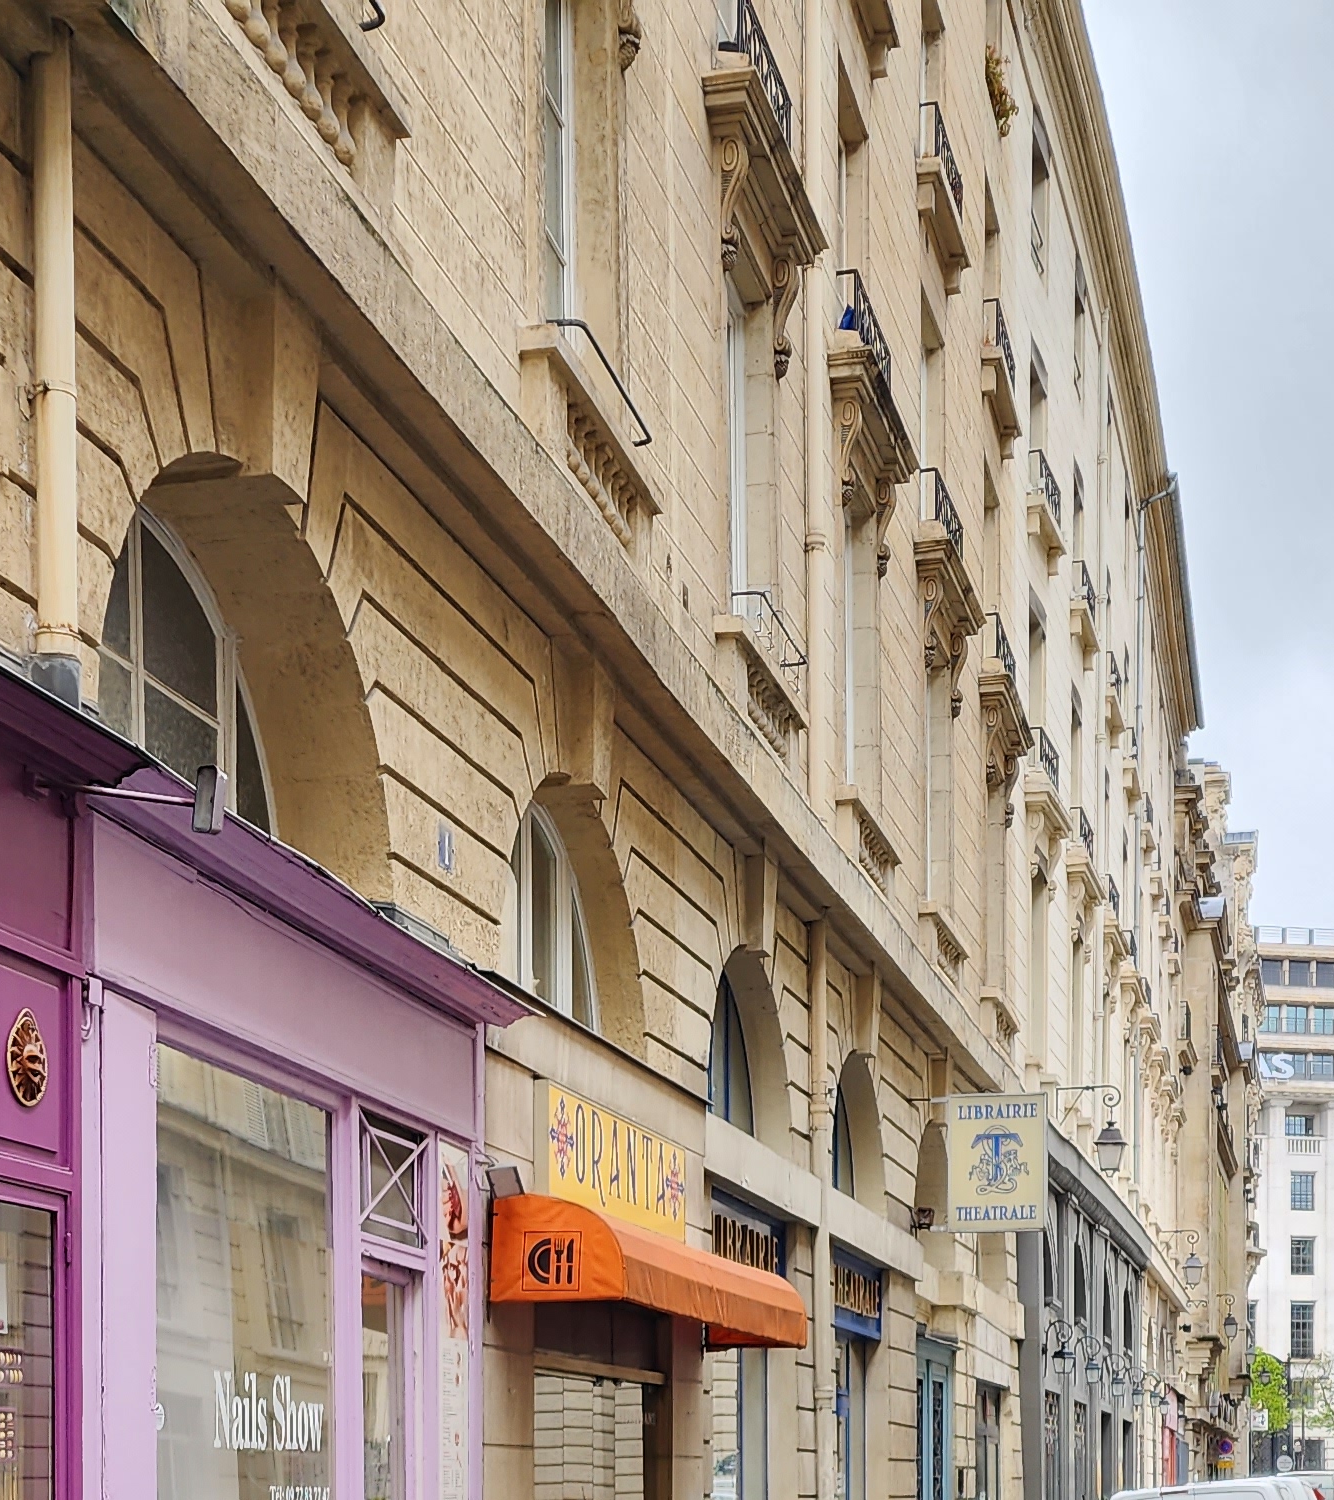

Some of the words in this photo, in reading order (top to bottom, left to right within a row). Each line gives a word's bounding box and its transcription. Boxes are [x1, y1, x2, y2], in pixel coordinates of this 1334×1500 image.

[958, 1103, 1038, 1120] LIBRAIRIE
[574, 1103, 667, 1217] ORANTA
[712, 1210, 780, 1275] LIBRAIRIE
[956, 1205, 1037, 1221] THEATRALE
[213, 1370, 268, 1451] Nails
[272, 1374, 324, 1452] Show
